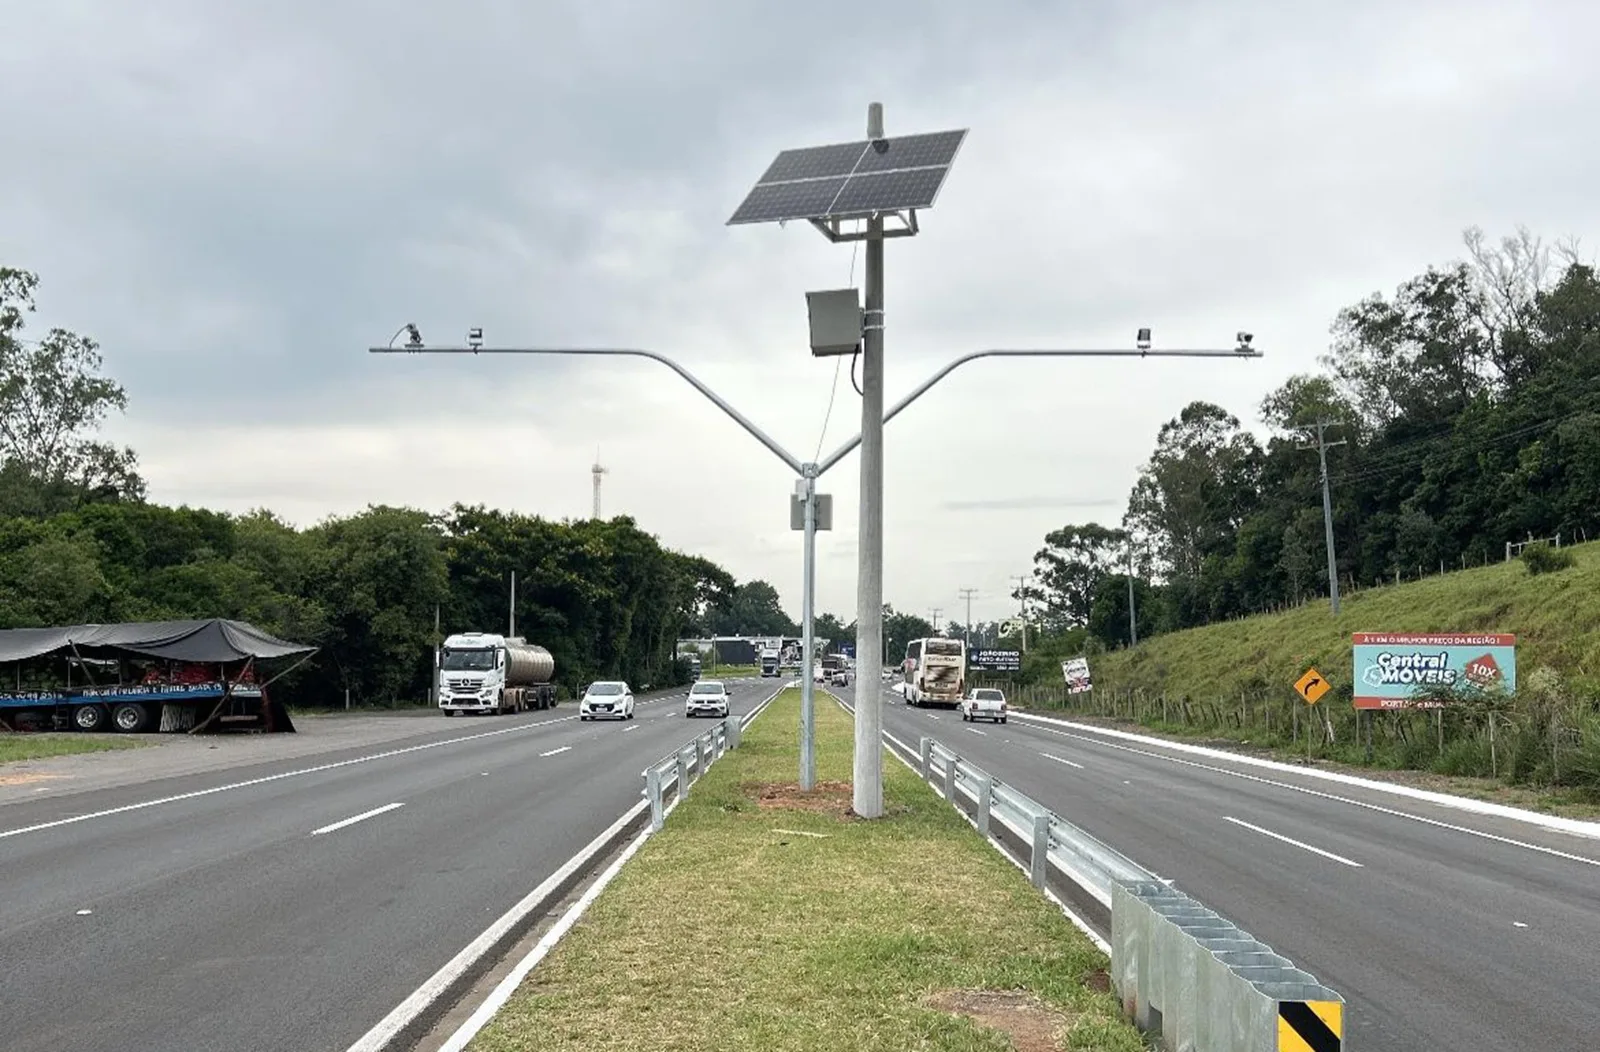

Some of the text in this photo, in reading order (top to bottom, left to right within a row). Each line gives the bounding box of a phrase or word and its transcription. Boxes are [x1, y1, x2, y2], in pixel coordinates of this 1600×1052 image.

[1396, 636, 1428, 644] MELHOR
[1428, 637, 1453, 645] PREÇO
[1467, 636, 1496, 644] REGIÃO
[1377, 652, 1446, 668] Central
[1382, 667, 1456, 685] MÓVEIS
